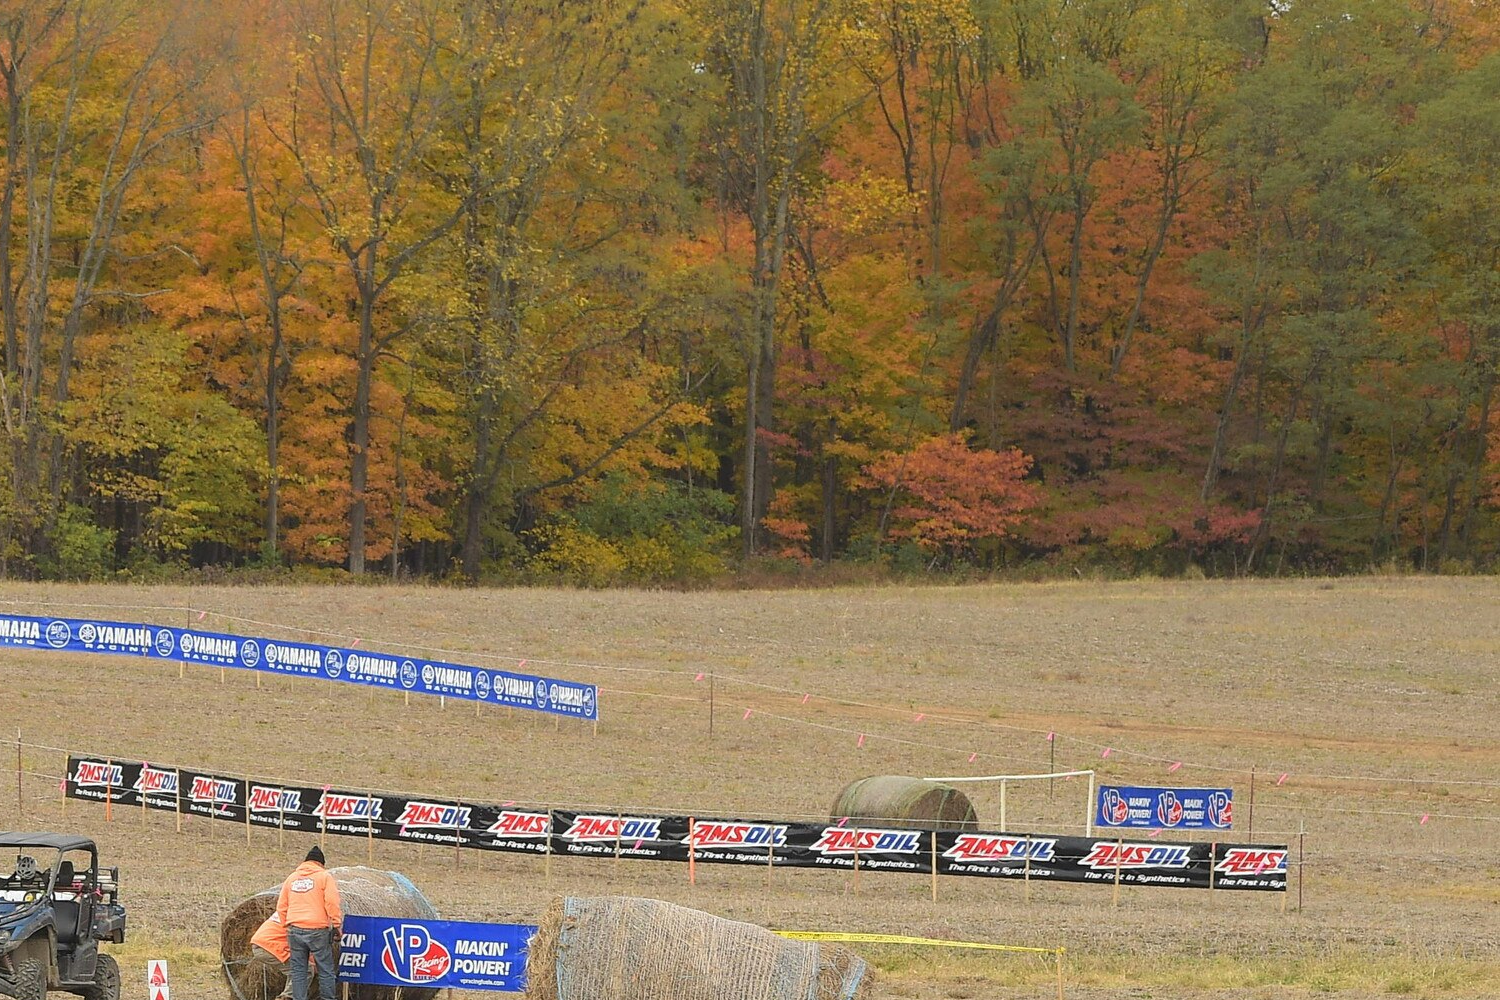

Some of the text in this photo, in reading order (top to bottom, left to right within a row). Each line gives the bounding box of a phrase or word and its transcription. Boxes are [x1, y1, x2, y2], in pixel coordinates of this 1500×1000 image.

[97, 626, 152, 647] YAMAHA
[193, 636, 237, 657] YAMAHA
[85, 643, 149, 653] RACING
[182, 652, 234, 664] RACING
[277, 646, 321, 668] YAMAHA
[268, 662, 318, 674] RACING
[358, 656, 398, 678] YAMAHA
[350, 673, 394, 685] RACING
[434, 666, 472, 690] YAMAHA
[503, 677, 534, 699] YAMAHA
[77, 762, 122, 784] AMSOIL
[138, 769, 178, 790] AMSOIL
[192, 779, 236, 800] AMSOIL
[250, 788, 298, 810] AMSOIL
[317, 796, 380, 817] AMSOIL
[400, 804, 468, 826] AMSOIL
[492, 814, 549, 834] AMS
[567, 818, 659, 840] AMSOIL
[688, 824, 786, 845] AMSOIL
[814, 830, 919, 852] AMSOIL
[949, 837, 1054, 859] AMSOIL
[866, 860, 915, 868] Synthetics
[1084, 845, 1189, 866] AMSOIL
[1219, 851, 1286, 872] AMS
[1136, 874, 1186, 883] Synthetics
[1219, 878, 1234, 886] The
[383, 924, 431, 982] VP
[455, 940, 508, 957] MAKIN'
[412, 954, 449, 974] Racing
[453, 959, 512, 976] POWER!
